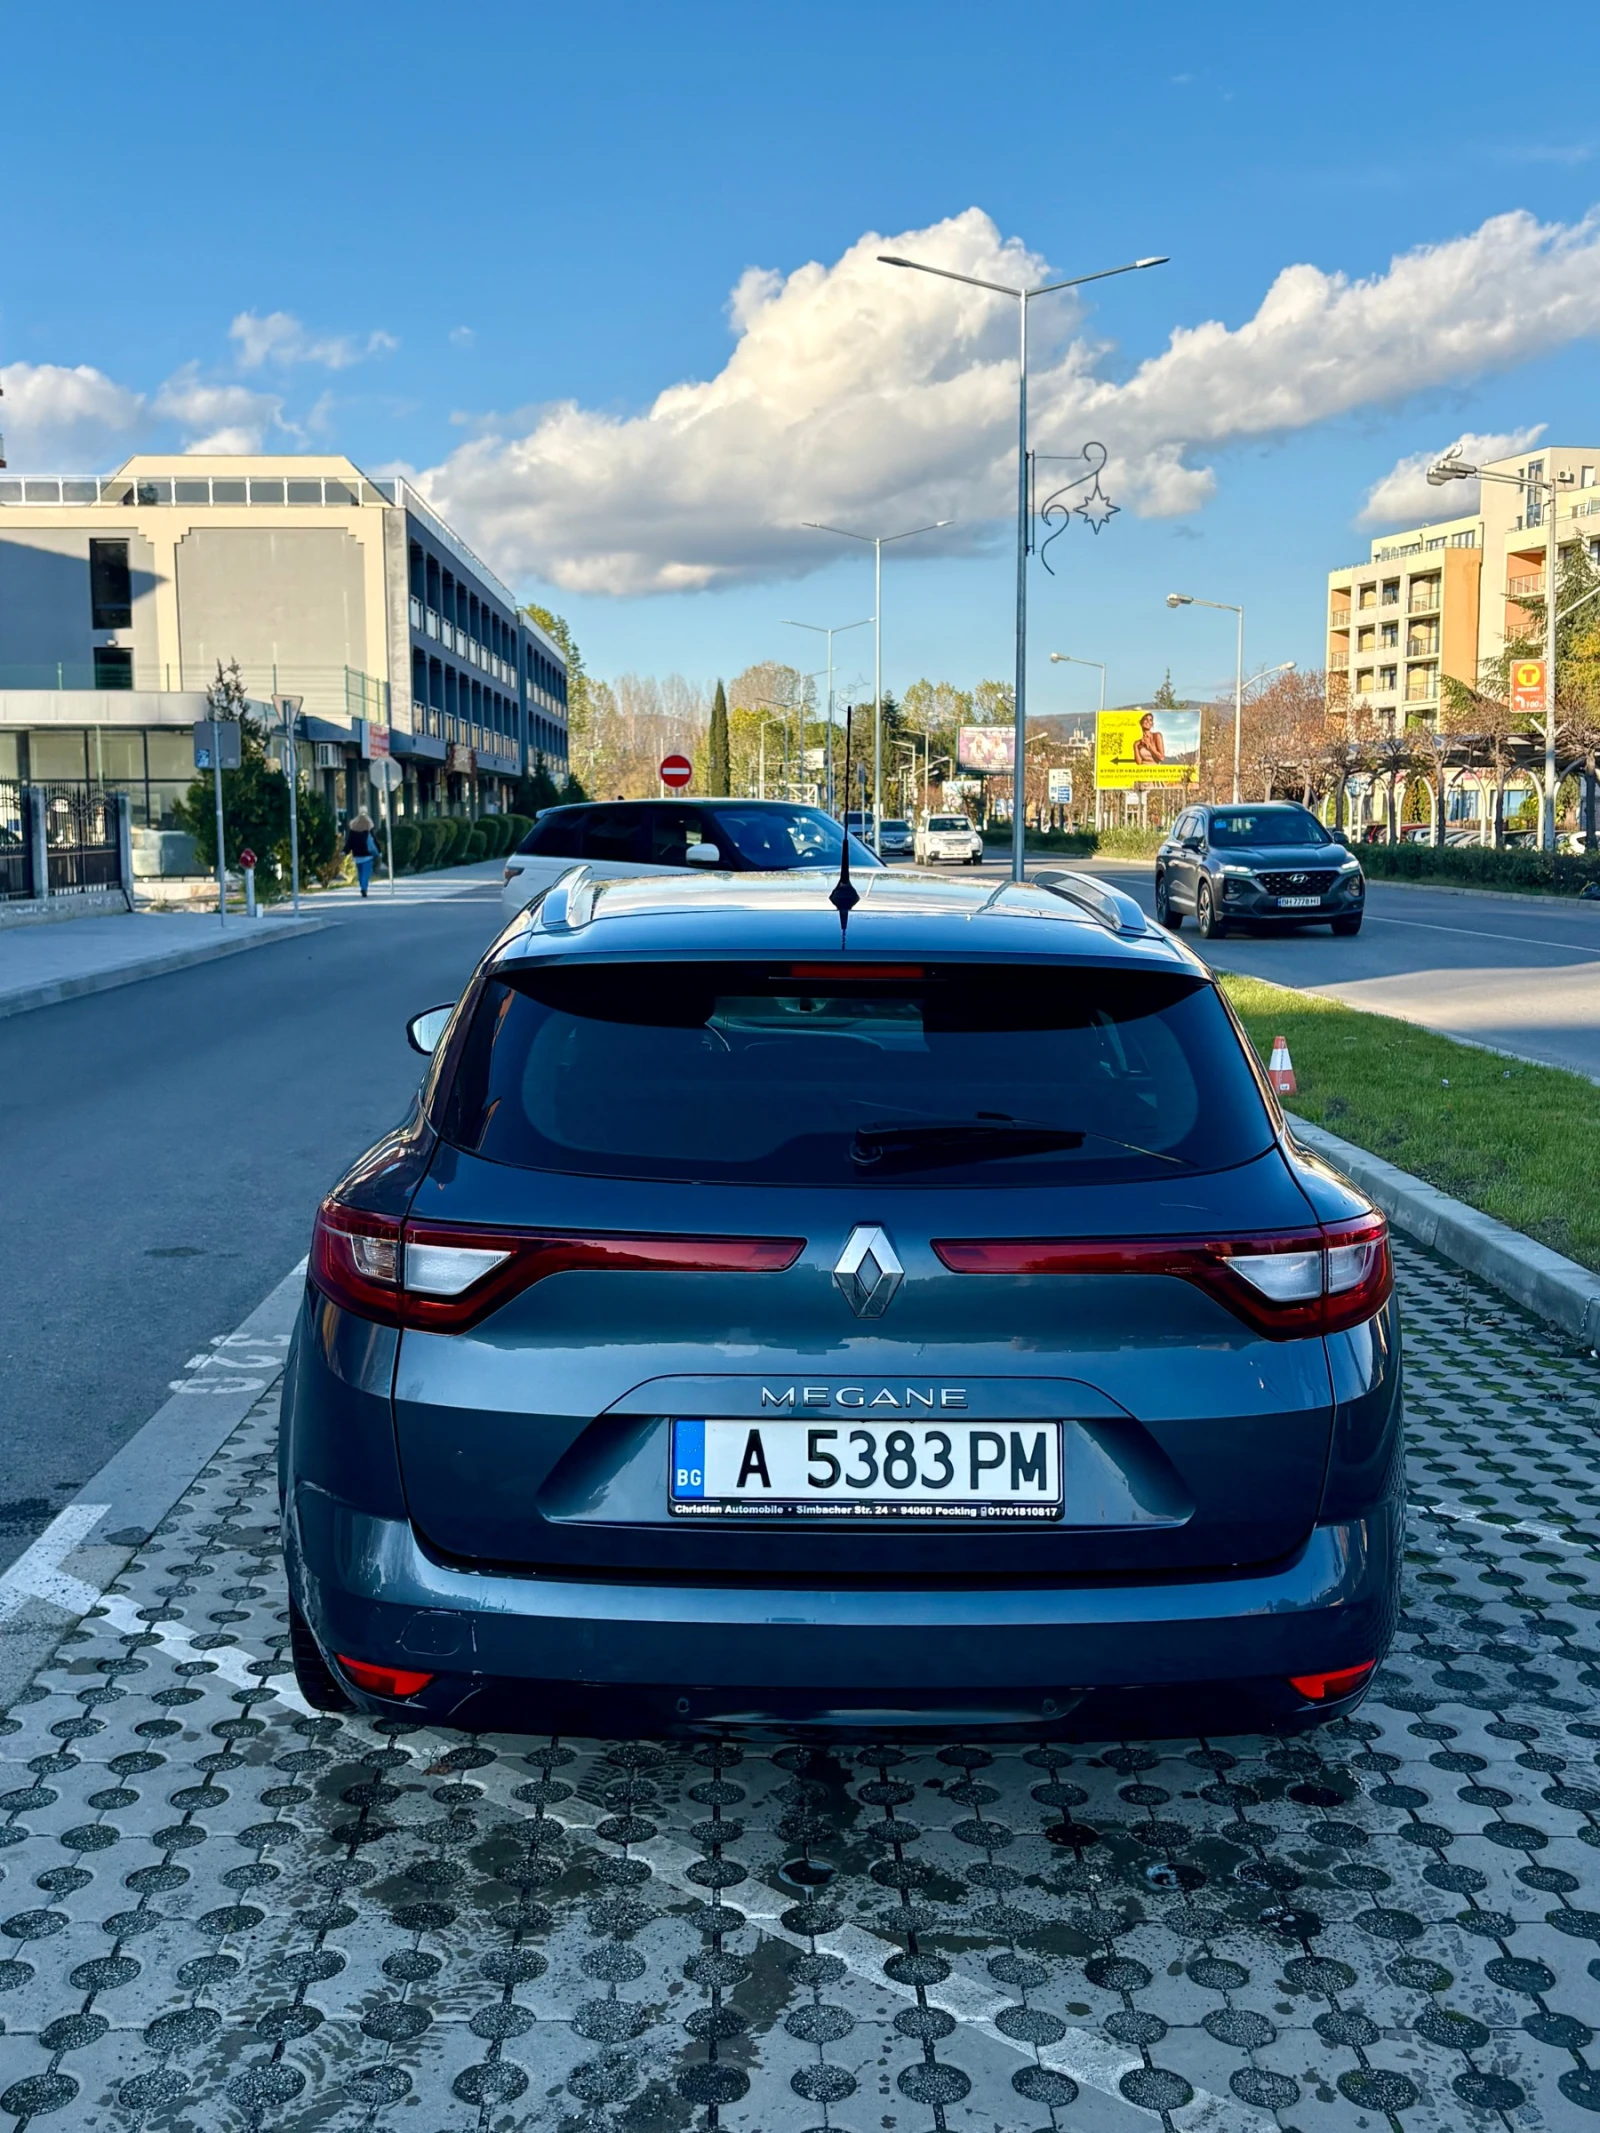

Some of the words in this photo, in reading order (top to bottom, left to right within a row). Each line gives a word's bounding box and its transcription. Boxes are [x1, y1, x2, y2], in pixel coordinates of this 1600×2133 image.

[1522, 669, 1536, 683] T
[761, 1386, 969, 1409] MEGANE
[736, 1429, 772, 1488] A
[807, 1429, 955, 1489] 5383
[969, 1431, 1048, 1490] PM
[676, 1469, 702, 1487] BG
[674, 1504, 722, 1514] Christian
[724, 1504, 784, 1514] Automobile
[796, 1505, 852, 1515] Simbacher
[854, 1505, 872, 1515] Str.
[875, 1505, 888, 1515] 24
[935, 1506, 977, 1517] Pocking
